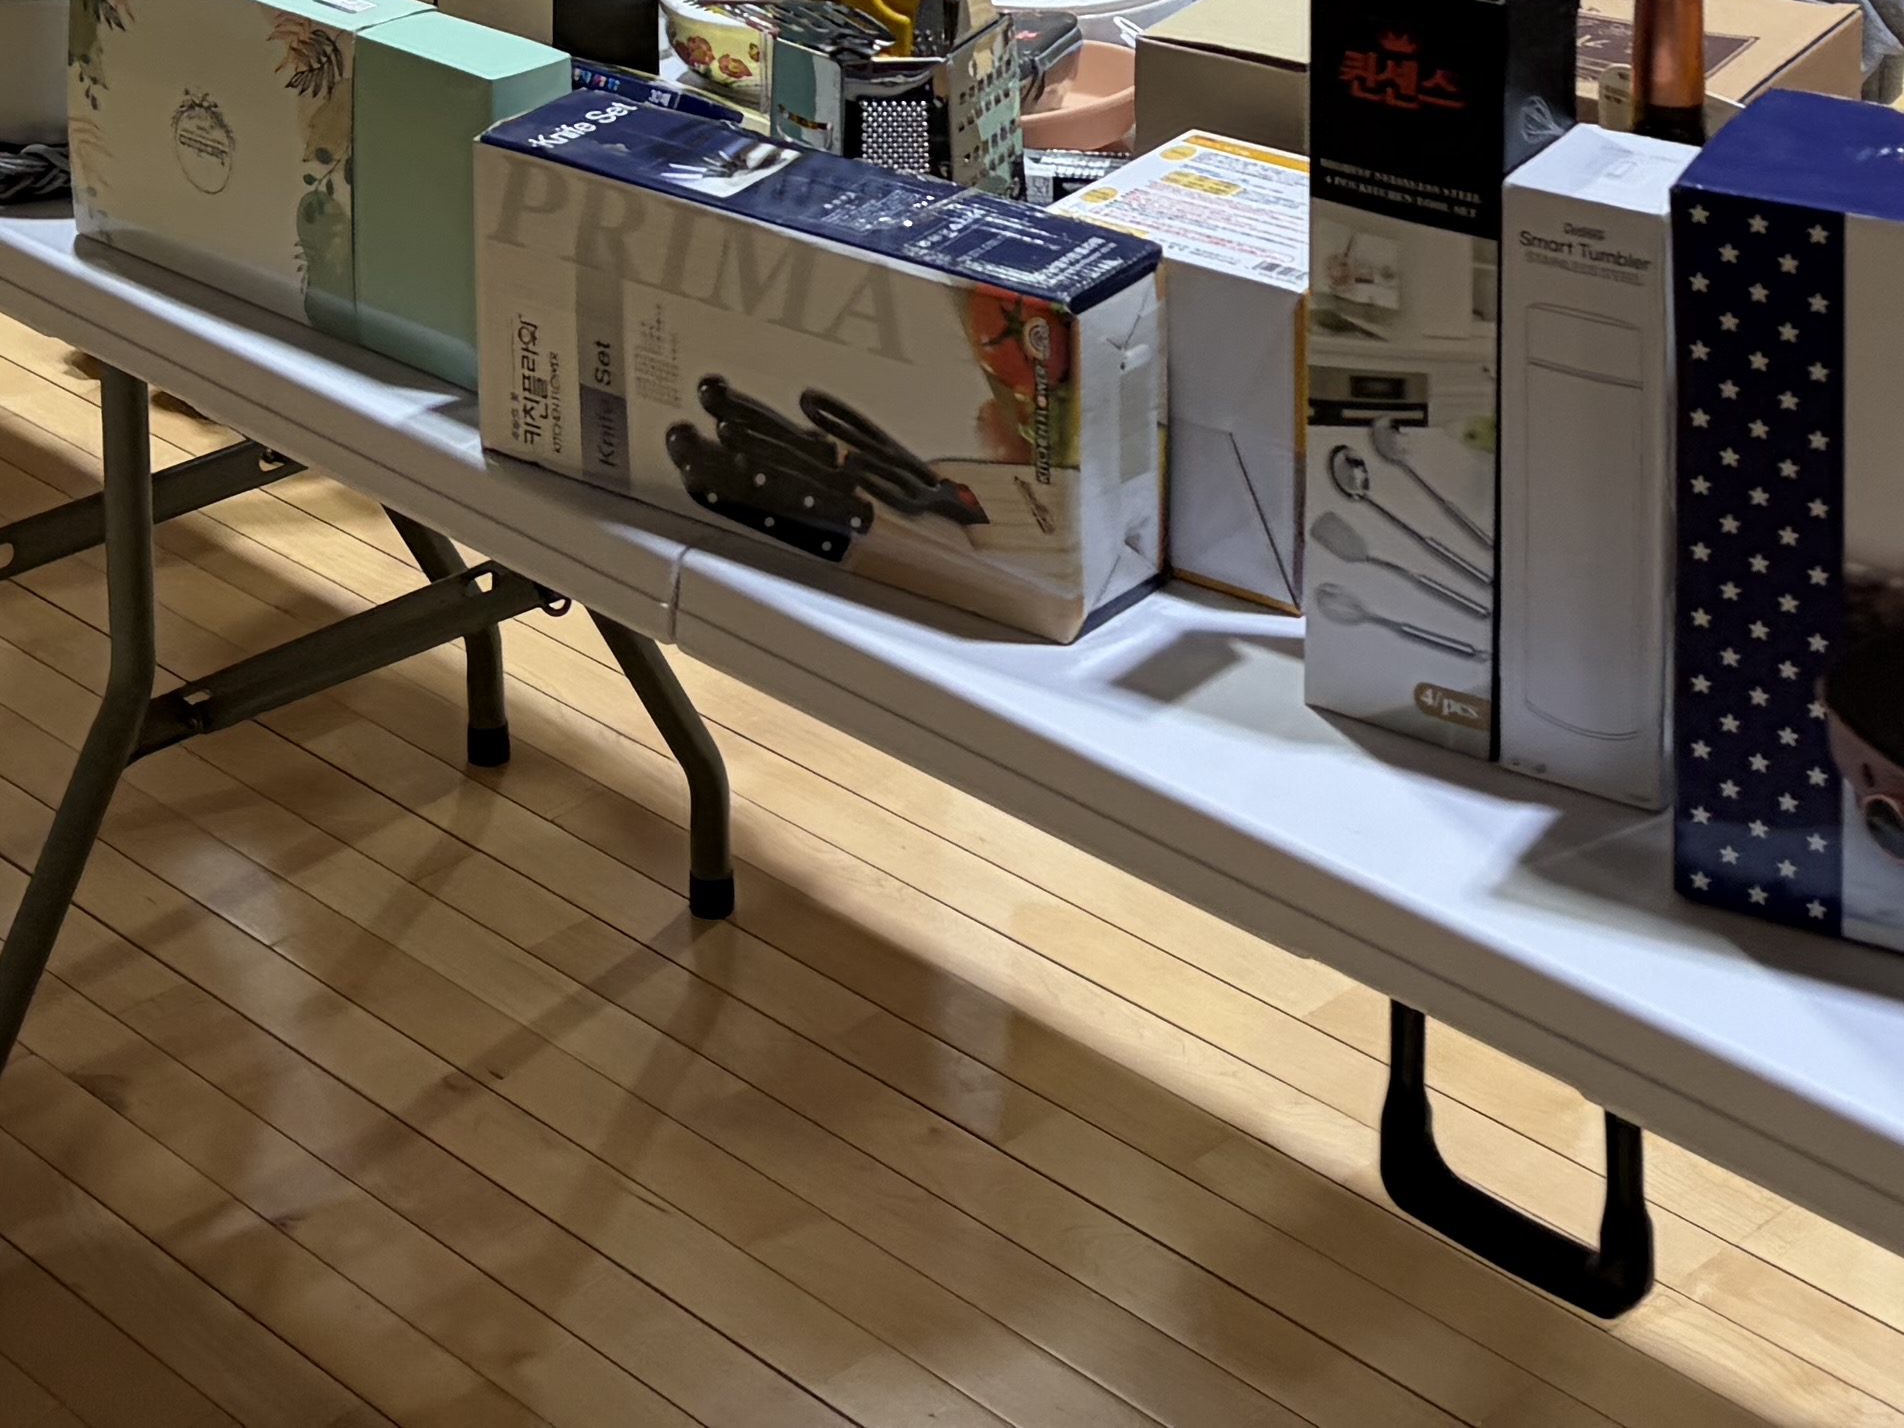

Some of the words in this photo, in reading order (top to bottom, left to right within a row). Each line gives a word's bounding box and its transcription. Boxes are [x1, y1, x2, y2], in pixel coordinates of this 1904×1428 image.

[1337, 50, 1467, 111] 퀸센스
[528, 121, 597, 150] Knife
[585, 101, 638, 124] Set
[486, 153, 916, 366] PRIMA
[1520, 230, 1573, 255] Smart
[1578, 242, 1652, 271] Tumbler
[517, 318, 549, 446] 키친플라워
[594, 340, 612, 386] Set
